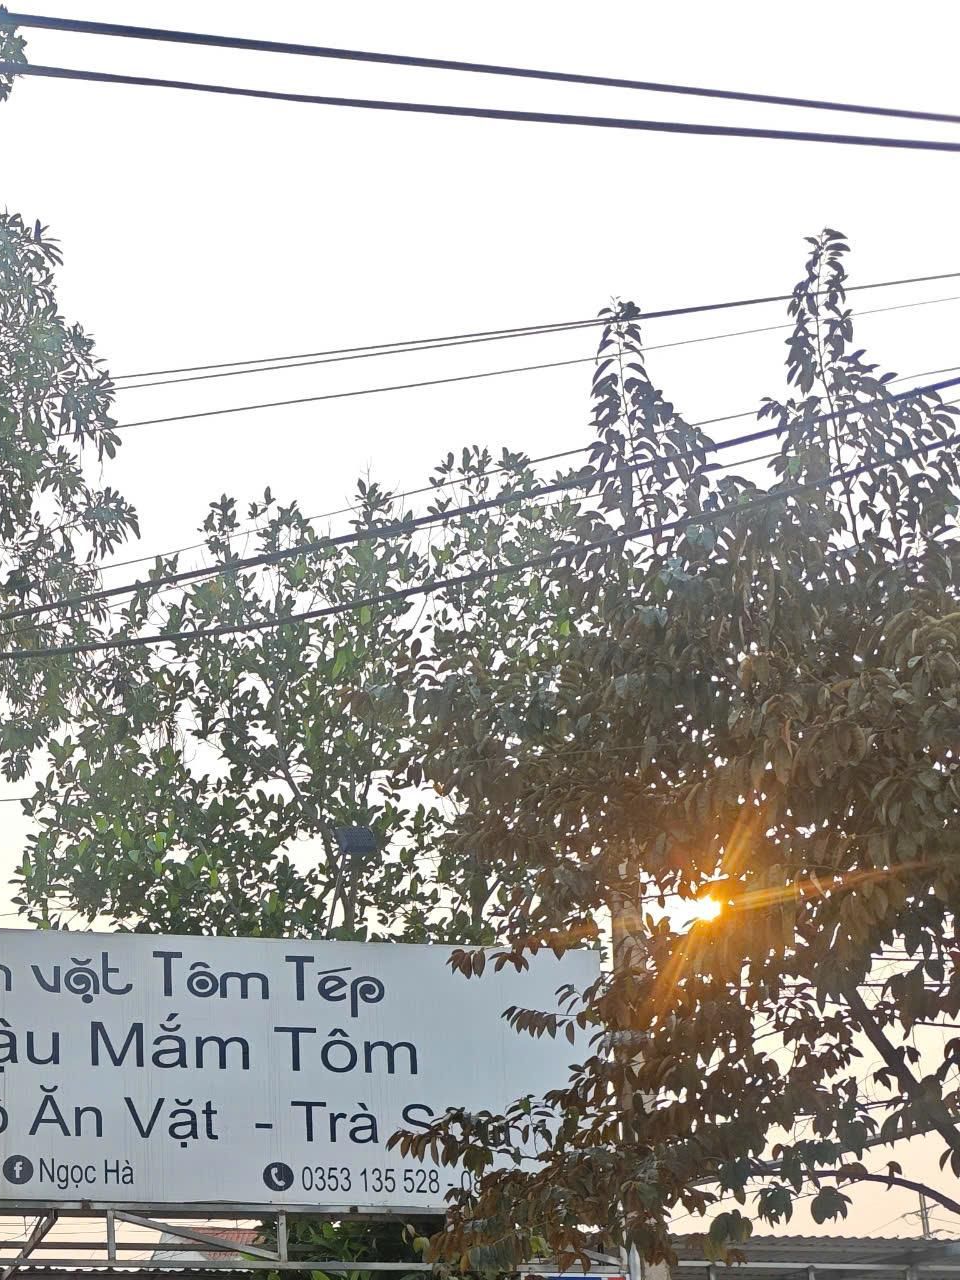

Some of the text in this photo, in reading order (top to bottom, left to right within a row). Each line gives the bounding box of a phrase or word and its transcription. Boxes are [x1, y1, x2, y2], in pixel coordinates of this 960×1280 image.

[30, 951, 133, 1004] vặt
[152, 950, 270, 1000] Tôm
[284, 955, 385, 1017] Tép
[90, 1013, 250, 1070] Mắm
[273, 1026, 418, 1075] Tôm
[28, 1084, 103, 1138] Ăn
[123, 1096, 219, 1149] Vặt
[290, 1100, 379, 1144] Trà
[39, 1158, 135, 1190] Ngọc Hà
[301, 1166, 352, 1192] 0353
[359, 1167, 397, 1194] 135
[403, 1168, 441, 1194] 528
